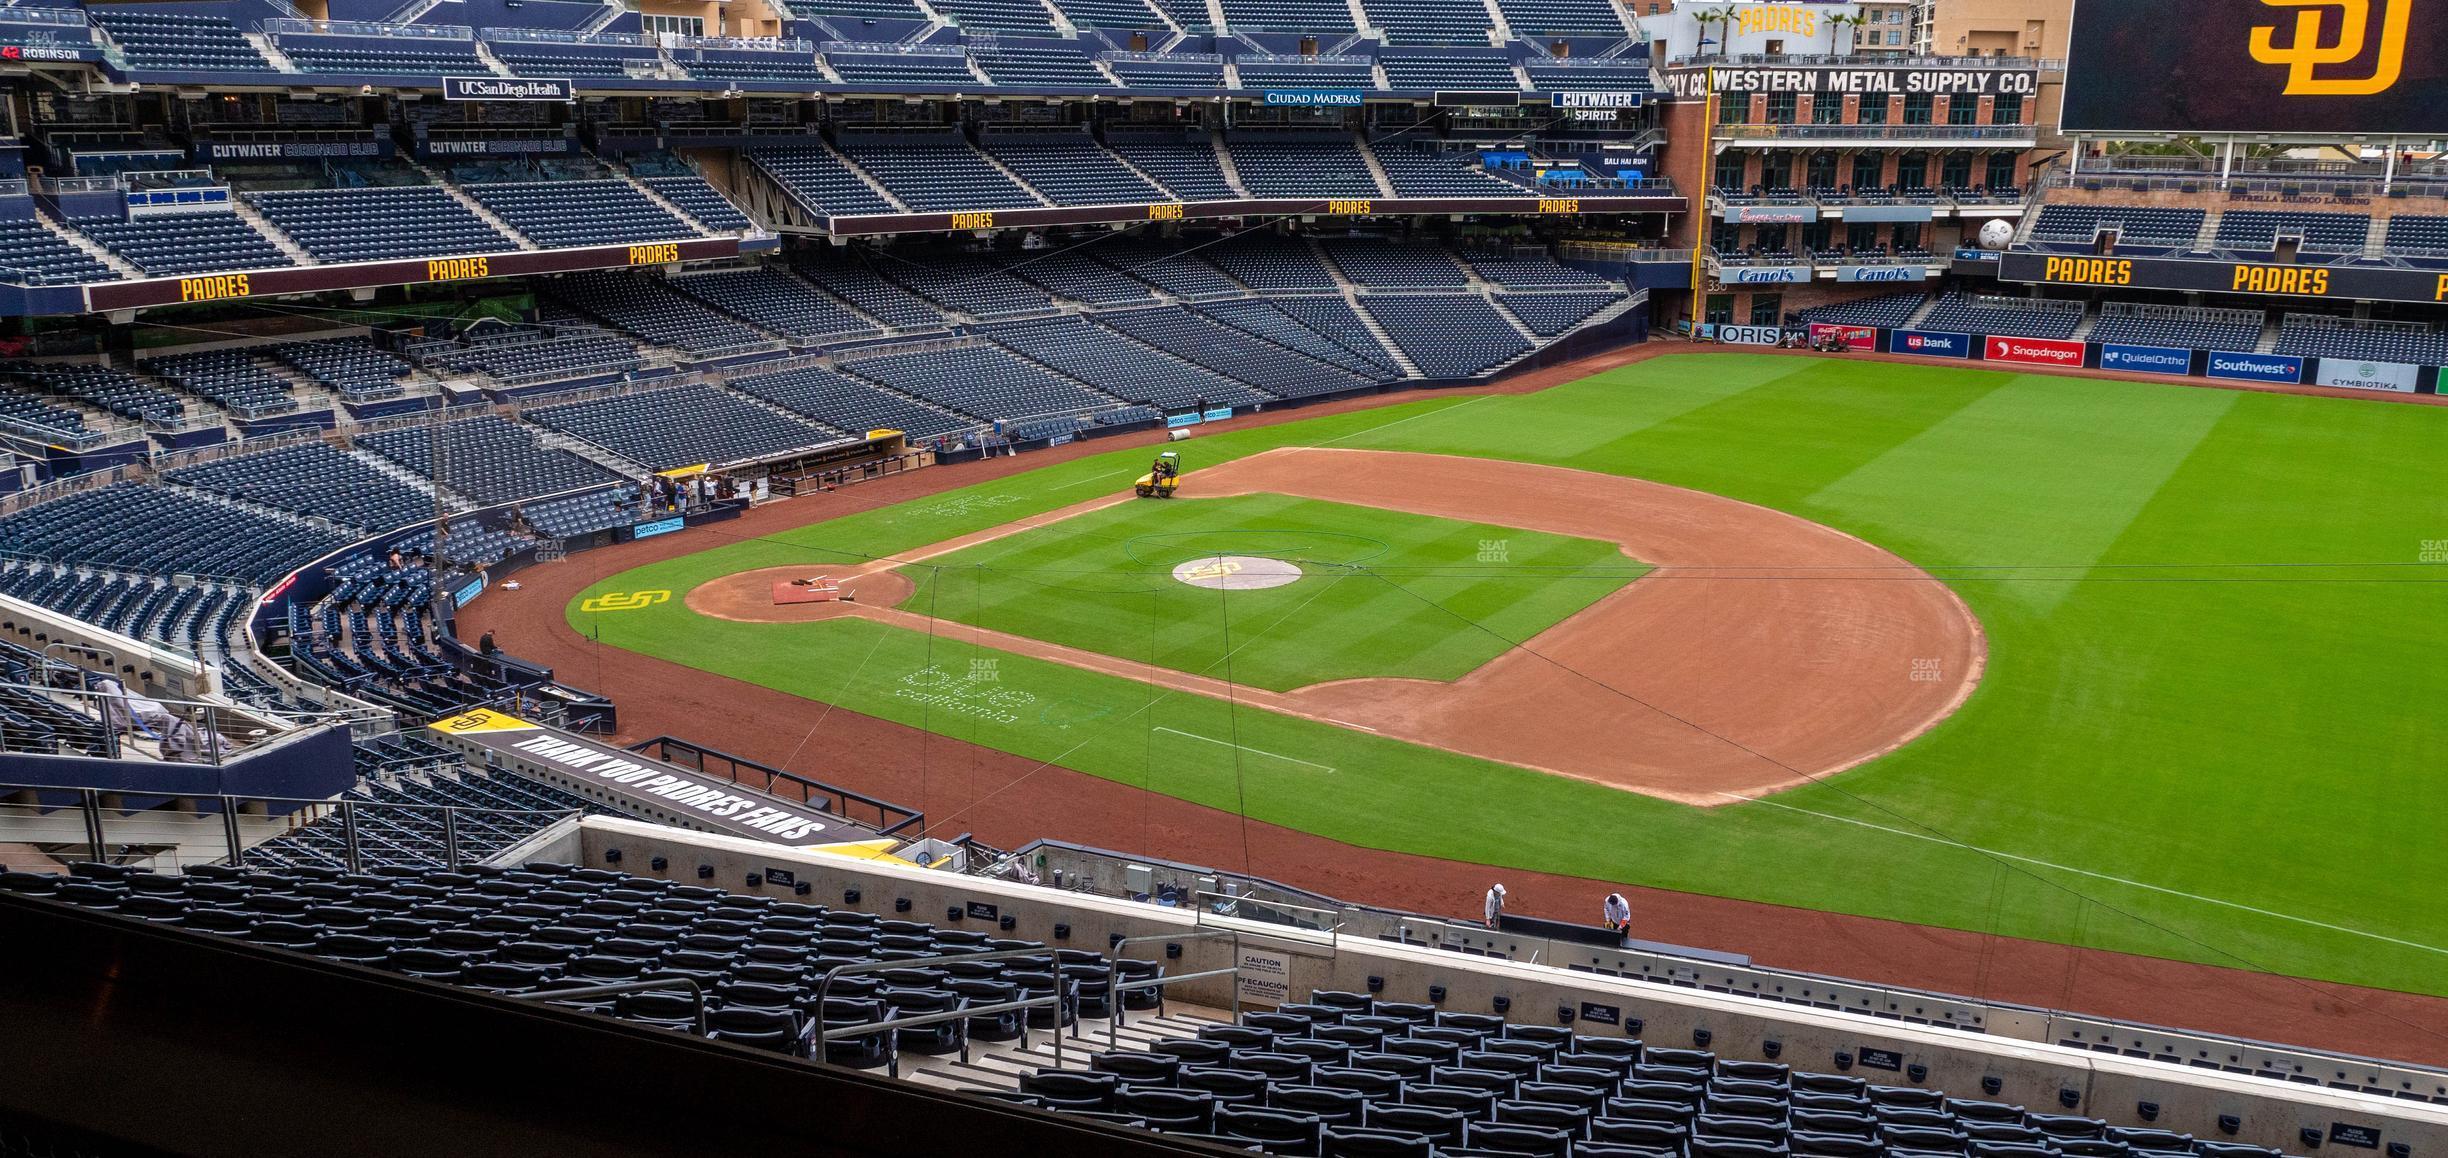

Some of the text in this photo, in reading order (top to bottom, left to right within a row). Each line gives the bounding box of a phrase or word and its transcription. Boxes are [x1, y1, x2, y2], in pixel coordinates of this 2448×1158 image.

[1738, 5, 1816, 38] PADRES
[1, 46, 80, 59] 42 ROBINSON
[458, 81, 561, 98] UC San Diego Health
[1712, 69, 2035, 95] WESTERN METAL SUPPLY CO.
[1267, 93, 1361, 104] CIUDAD MADERAS
[1562, 93, 1632, 107] CUTWATER
[1575, 110, 1618, 121] SPIRITS
[212, 142, 379, 158] CUTWATER CORONADO CLUB
[429, 139, 567, 153] CUTWATER CORONADO CLUB
[1328, 200, 1371, 215] PADRES
[1538, 199, 1579, 214] PADRES
[2229, 194, 2370, 206] ESTRELLA JALISCO LANDING
[1149, 204, 1183, 220] PADRES
[952, 212, 993, 230] PADRES
[629, 243, 678, 265] PADRES
[428, 257, 489, 281] PADRES
[1737, 267, 1795, 283] Canel's
[1855, 266, 1910, 281] Canel's
[2045, 256, 2132, 285] PADRES
[180, 274, 250, 302] PADRES
[2232, 265, 2329, 295] PADRES
[1722, 327, 1777, 344] ORIS
[1907, 338, 1952, 349] us bank
[2012, 345, 2078, 361] Snapdragon
[2121, 353, 2186, 366] QuidelOrtho
[2213, 359, 2286, 375] Southwest
[2331, 378, 2398, 390] CYMBIOTIKA
[636, 524, 659, 538] petco
[511, 734, 826, 840] THANK YOU PADRES FANS
[1245, 955, 1281, 967] CAUTION
